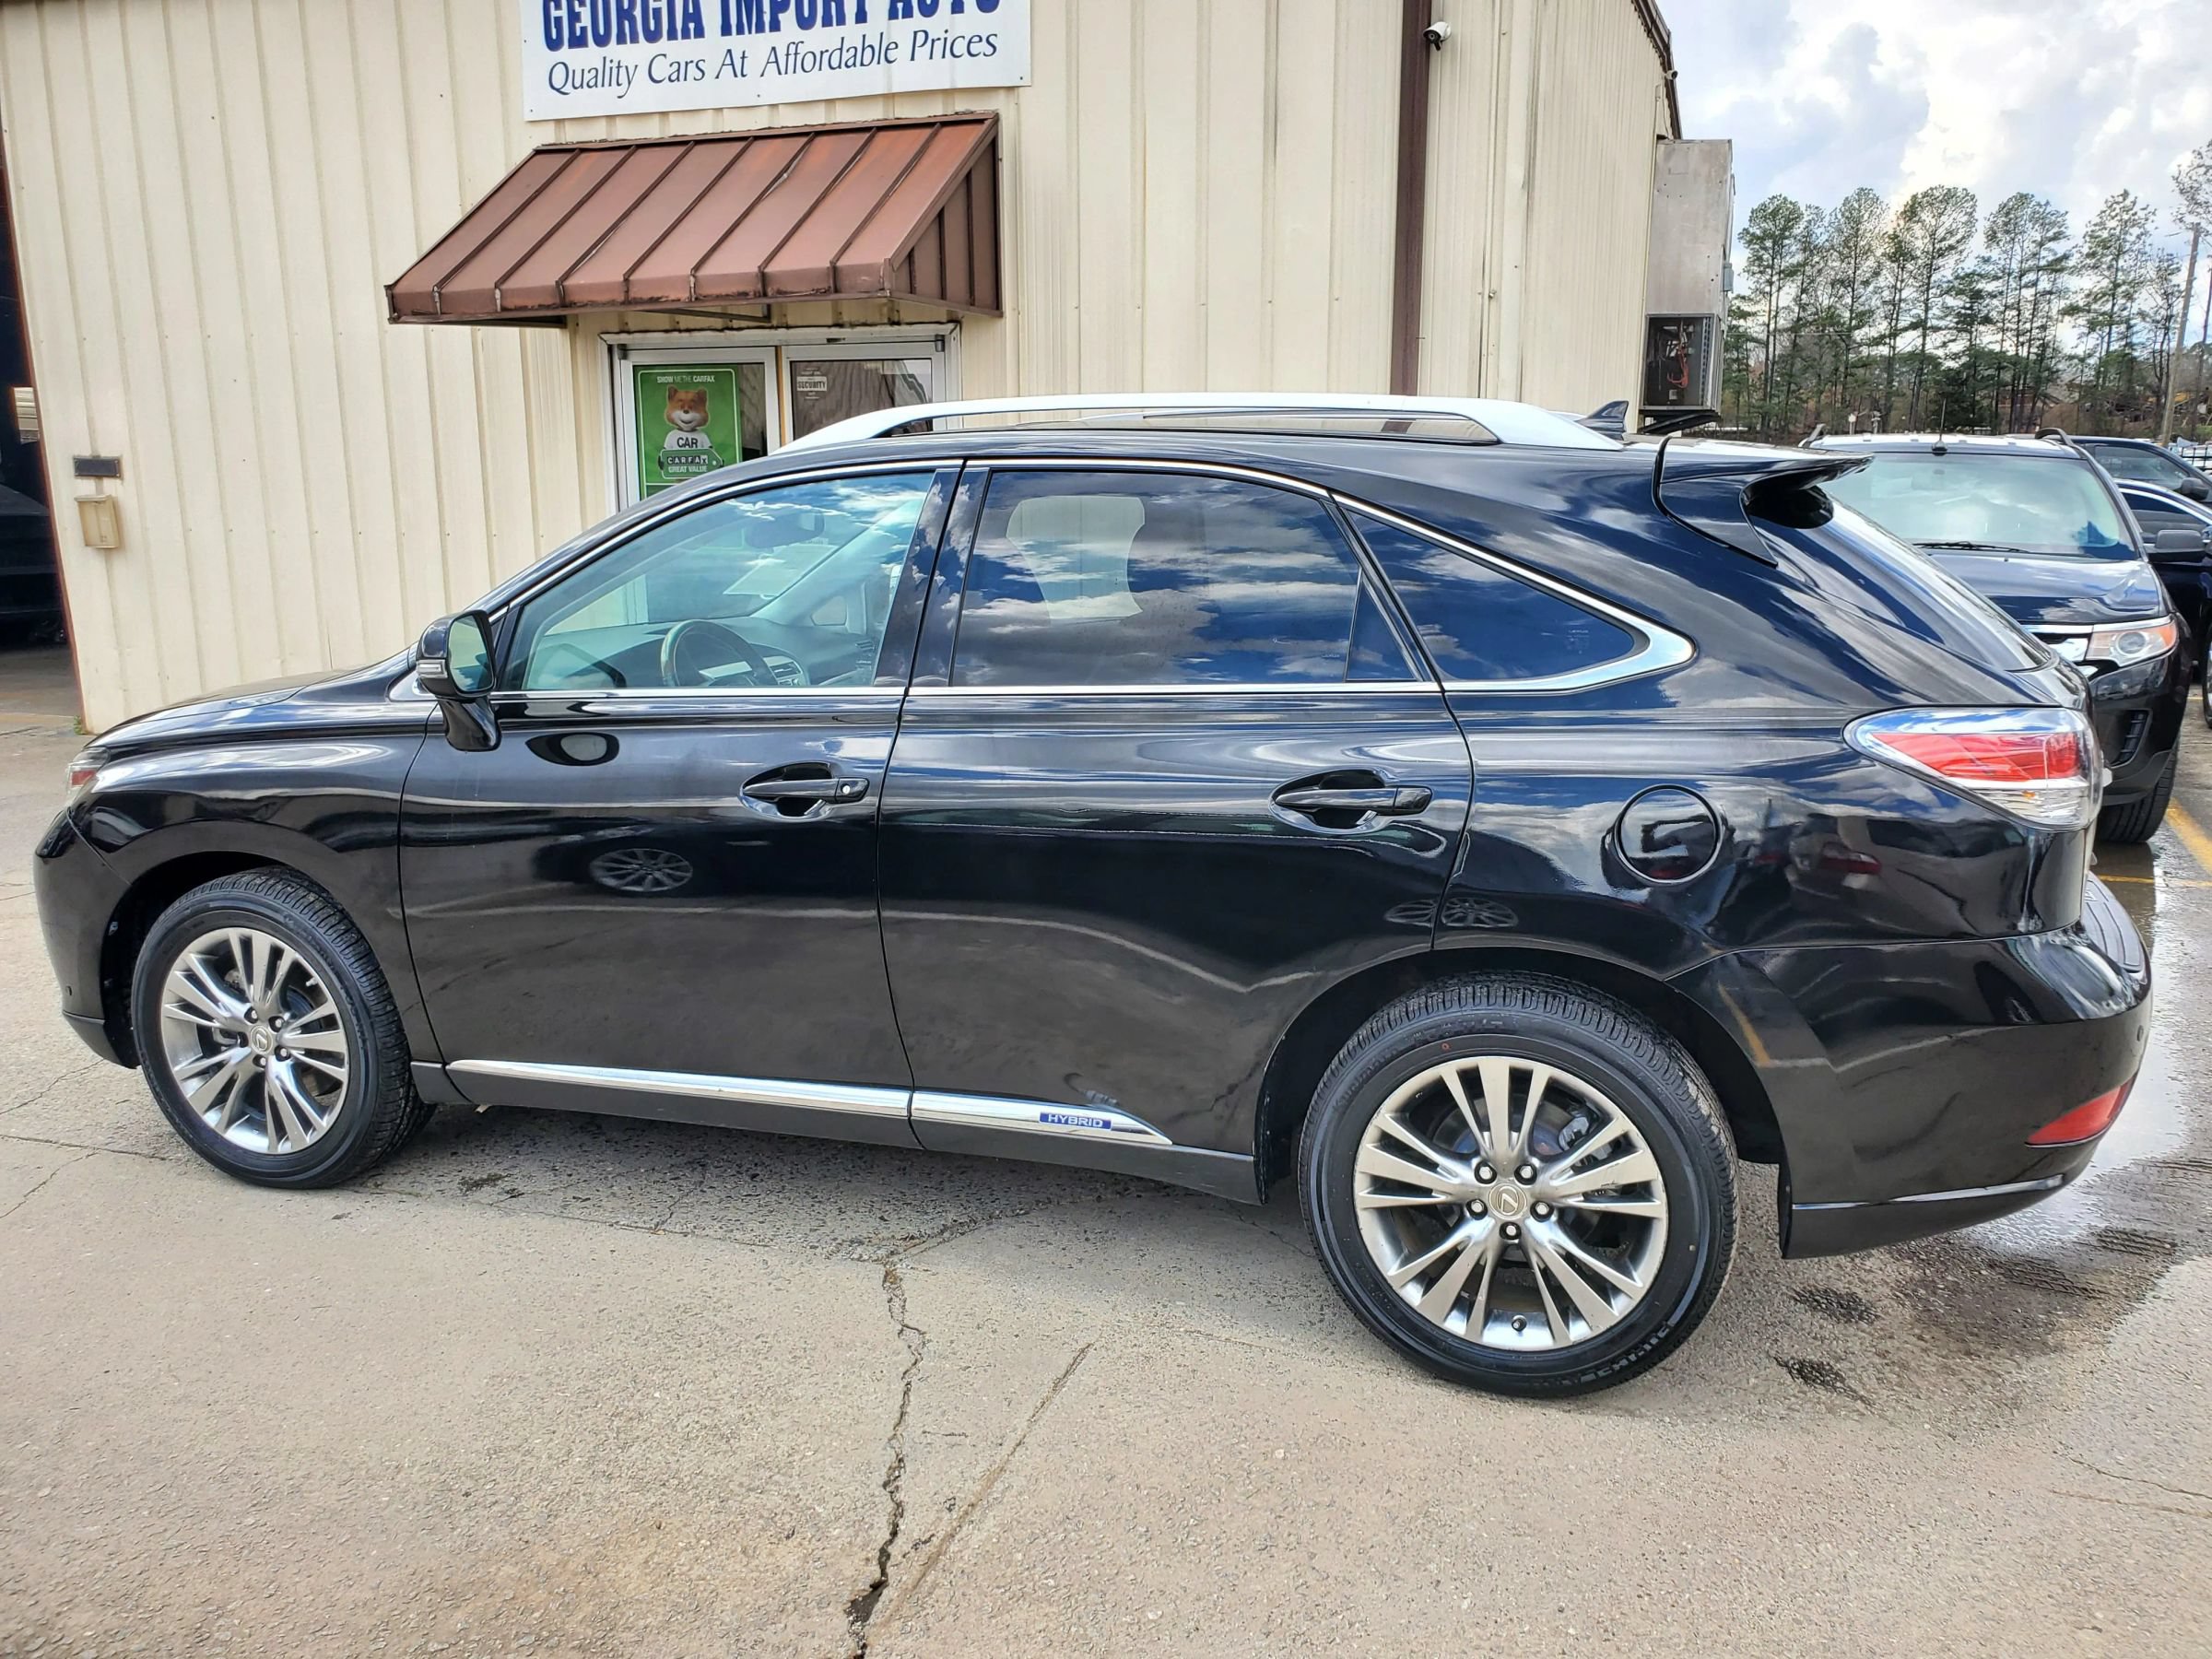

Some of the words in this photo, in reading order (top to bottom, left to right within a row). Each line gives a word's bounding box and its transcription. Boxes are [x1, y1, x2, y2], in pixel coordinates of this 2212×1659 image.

[543, 0, 705, 52] GEORGIA
[548, 56, 639, 99] Quality
[648, 53, 706, 84] Cars
[714, 49, 748, 79] At
[760, 32, 899, 77] Affordable
[910, 29, 998, 61] Prices
[677, 437, 699, 449] CAR
[667, 455, 708, 465] CARFAX
[1048, 1113, 1104, 1127] HYBRID
